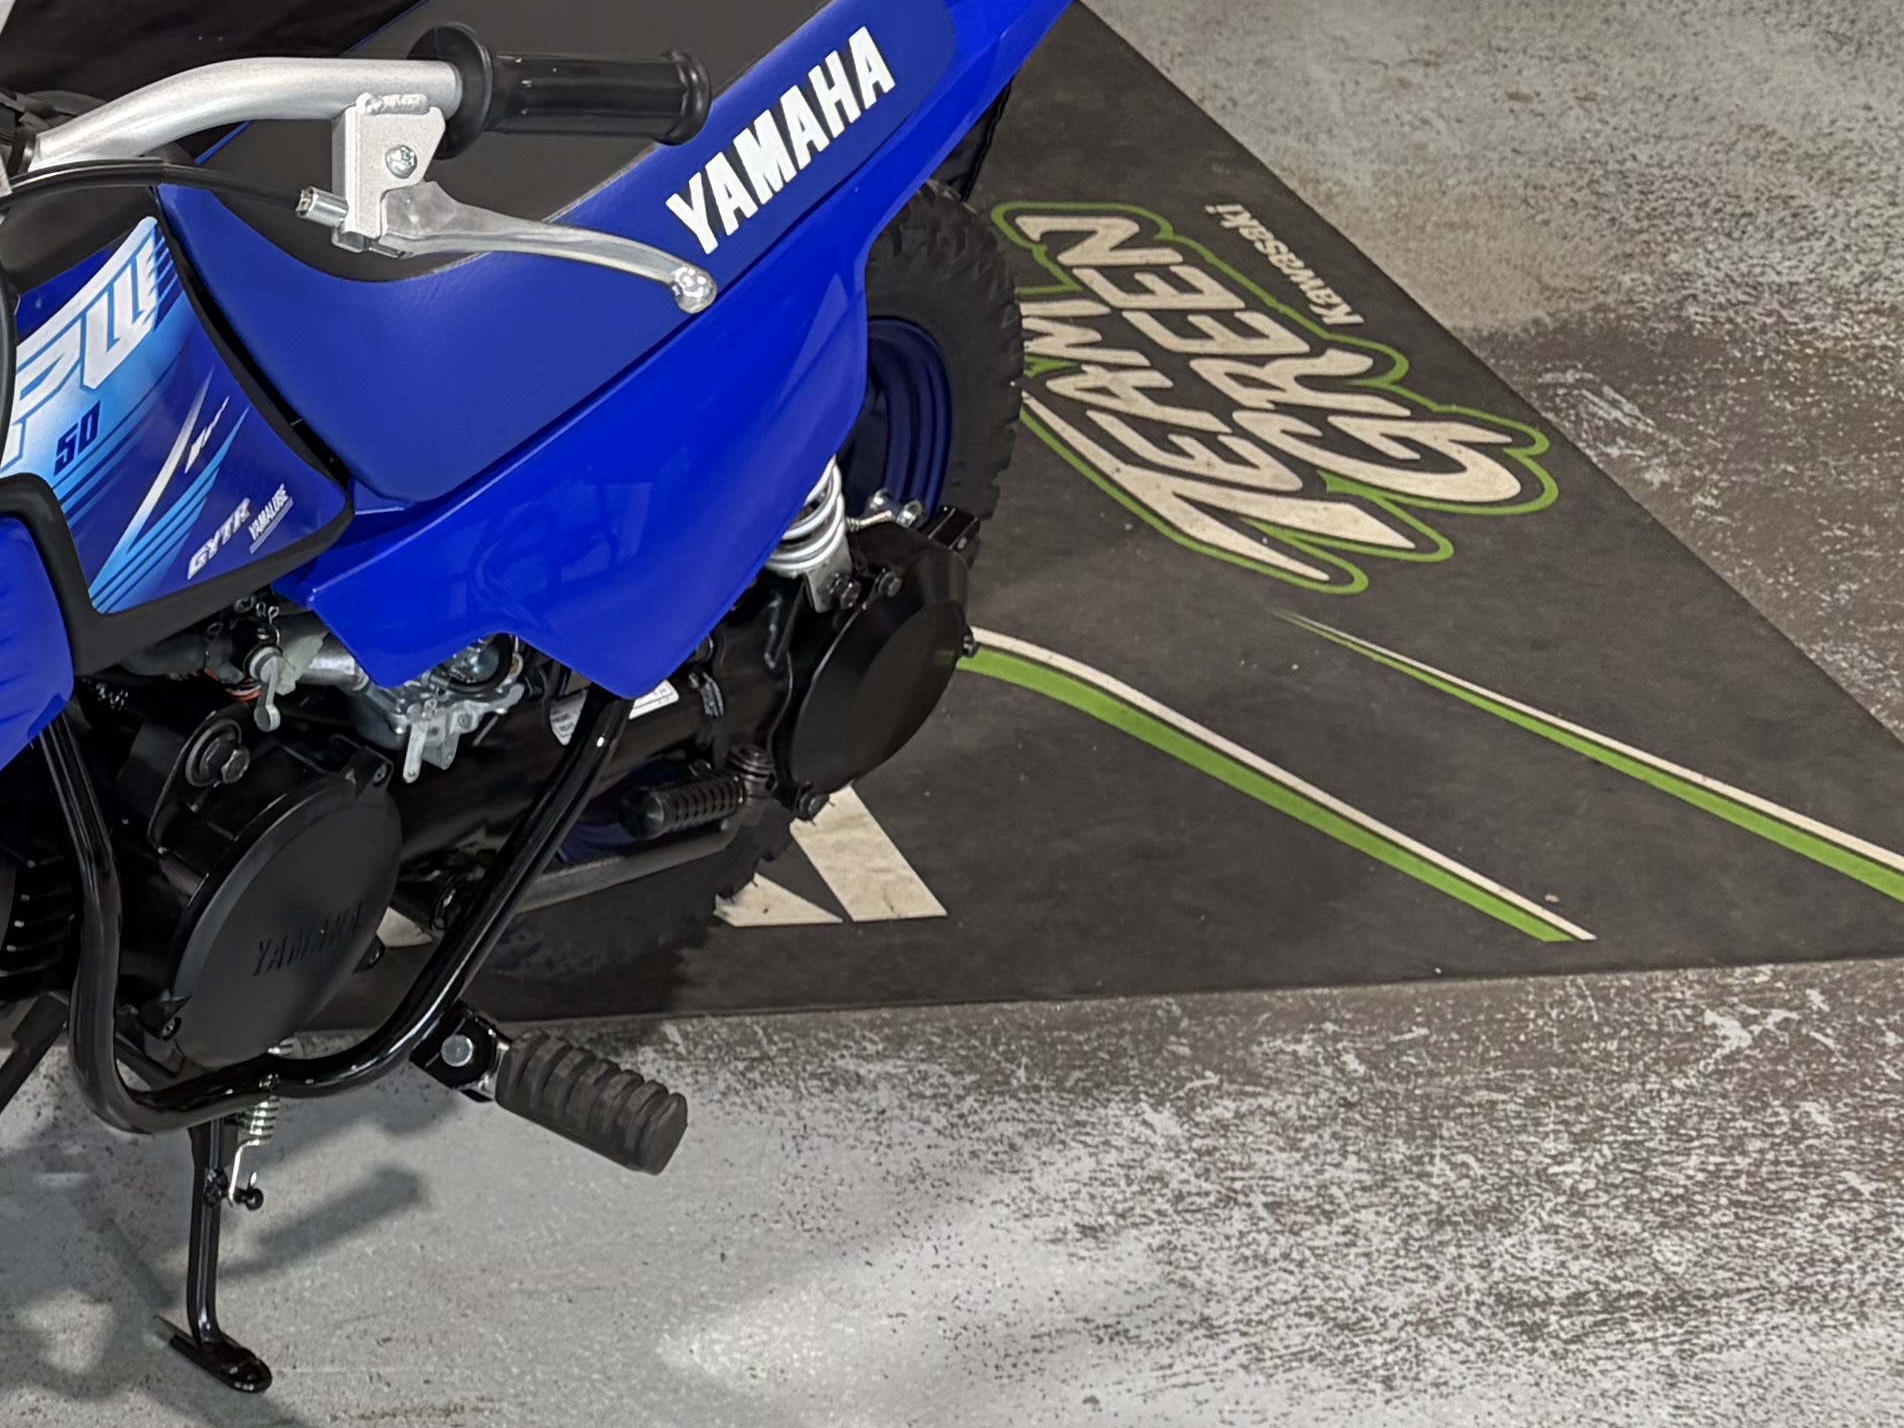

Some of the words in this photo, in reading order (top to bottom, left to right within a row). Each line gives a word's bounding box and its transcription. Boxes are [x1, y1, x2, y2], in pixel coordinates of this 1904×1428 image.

[665, 26, 896, 254] YAMAHA
[1204, 203, 1365, 325] Kawasaki
[1015, 216, 1521, 502] GREEN
[54, 400, 101, 476] 50
[187, 497, 251, 580] GYTR
